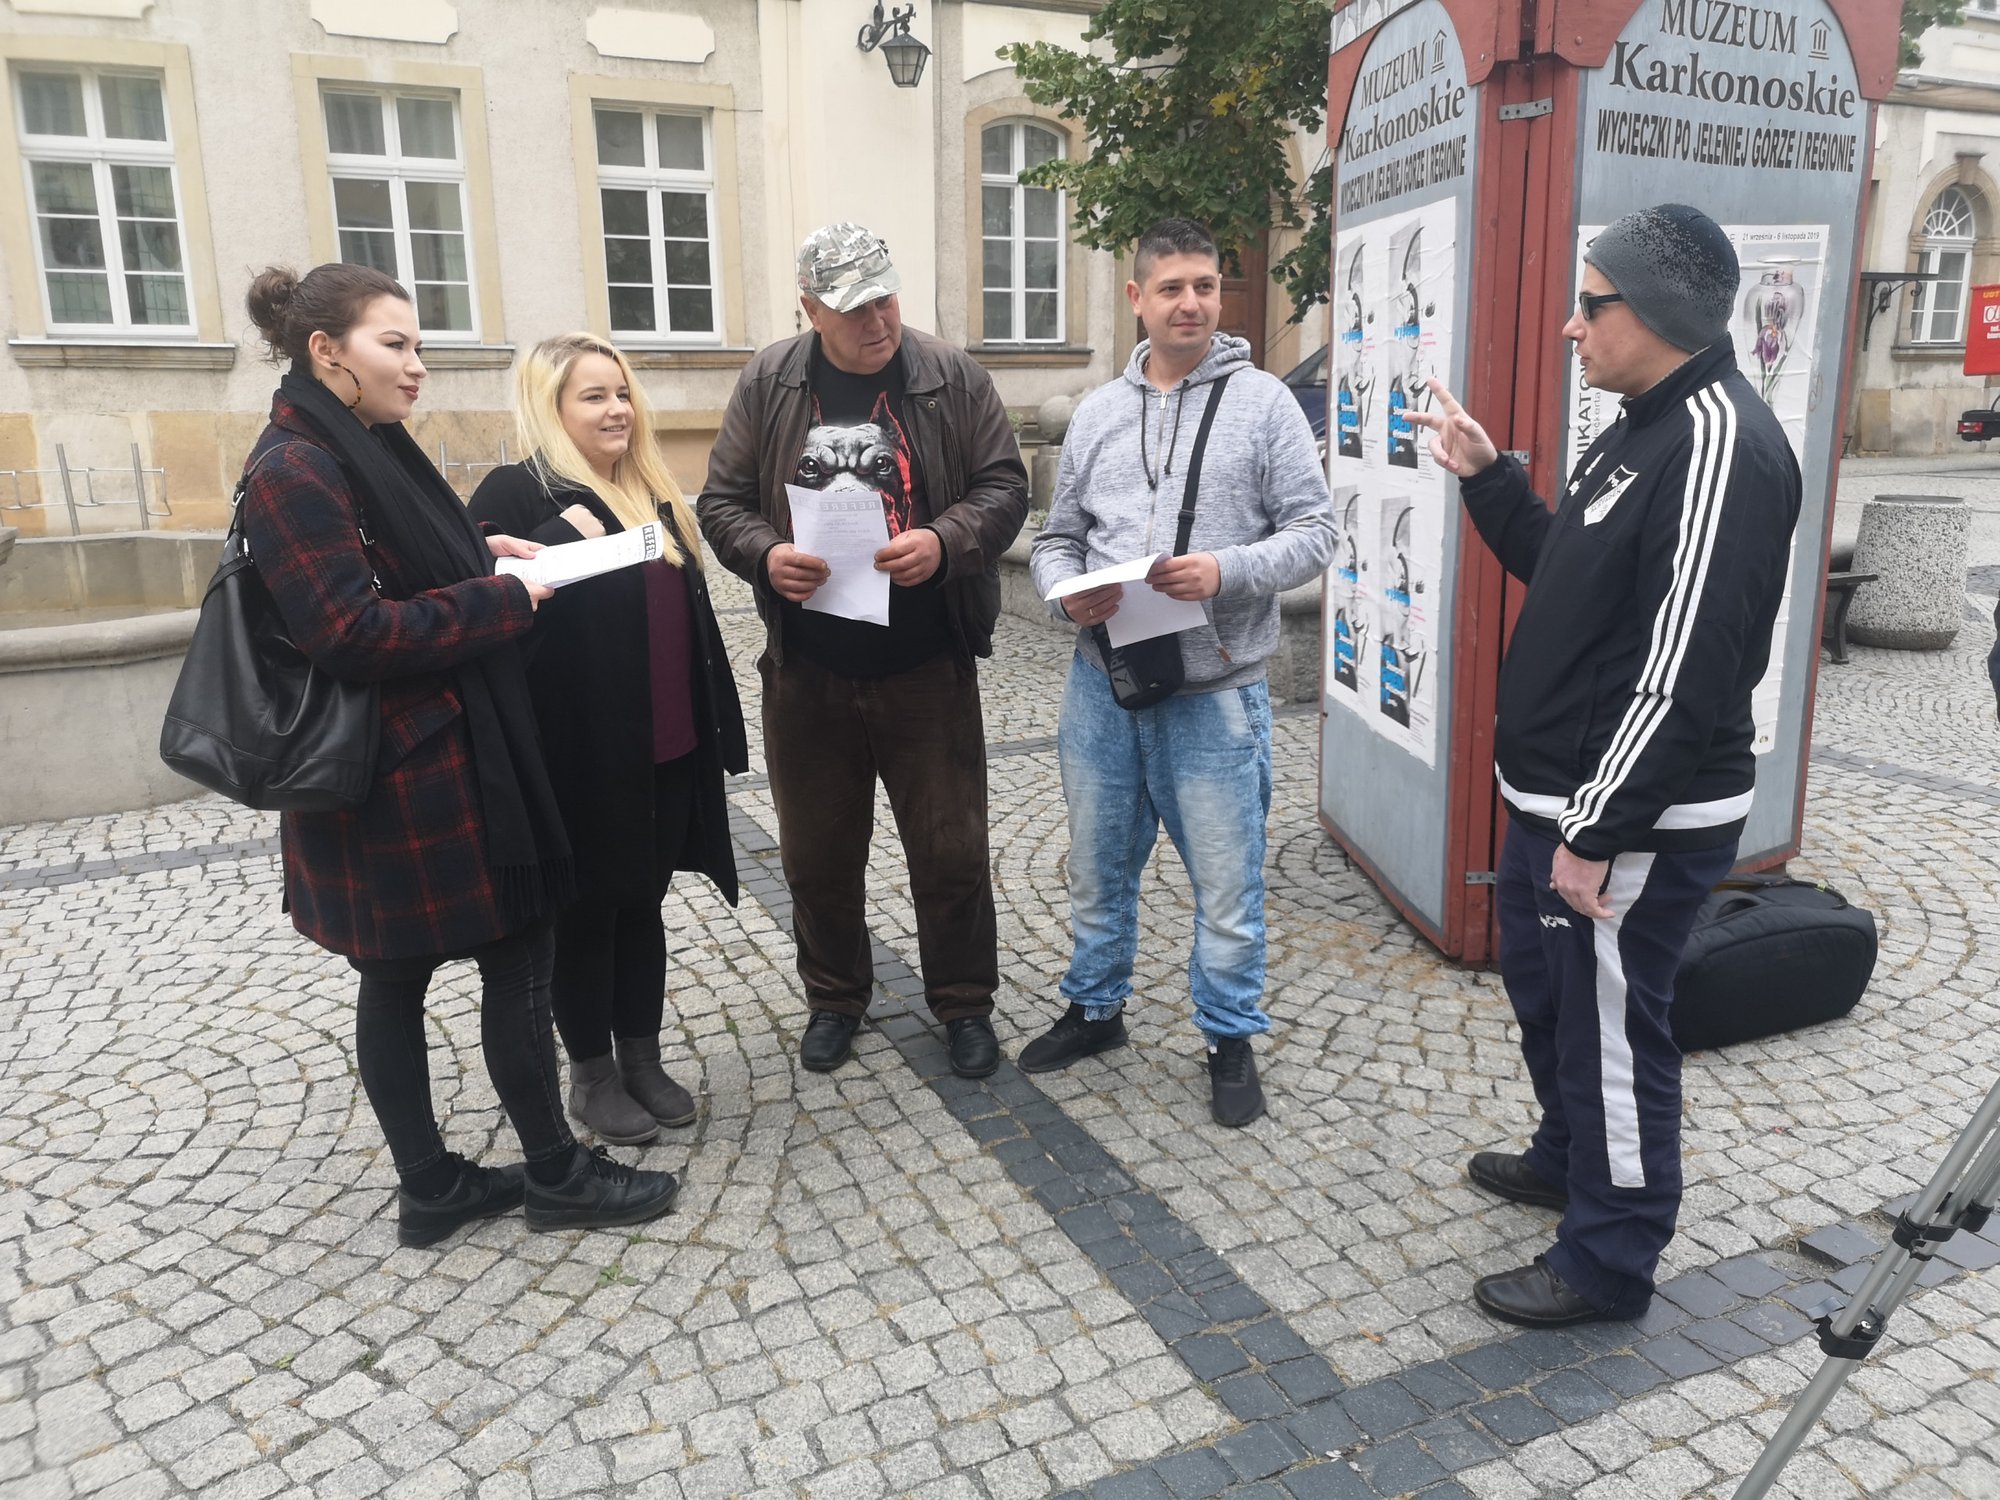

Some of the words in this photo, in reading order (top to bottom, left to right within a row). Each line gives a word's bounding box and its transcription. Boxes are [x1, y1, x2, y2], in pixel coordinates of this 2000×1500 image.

[1659, 0, 1798, 55] MUZEUM
[1361, 40, 1427, 110] MUZEUM
[1609, 40, 1856, 118] Karkonoskie
[1343, 78, 1466, 165] Karkonoskie
[1596, 108, 1673, 159] WYCIECZKI
[1672, 118, 1692, 161] PO
[1692, 122, 1751, 168] JELENIEJ
[1751, 118, 1796, 170] GÓRZE
[1795, 130, 1803, 170] I
[1802, 128, 1857, 173] REGIONIE
[1430, 134, 1467, 185] REGIONIE
